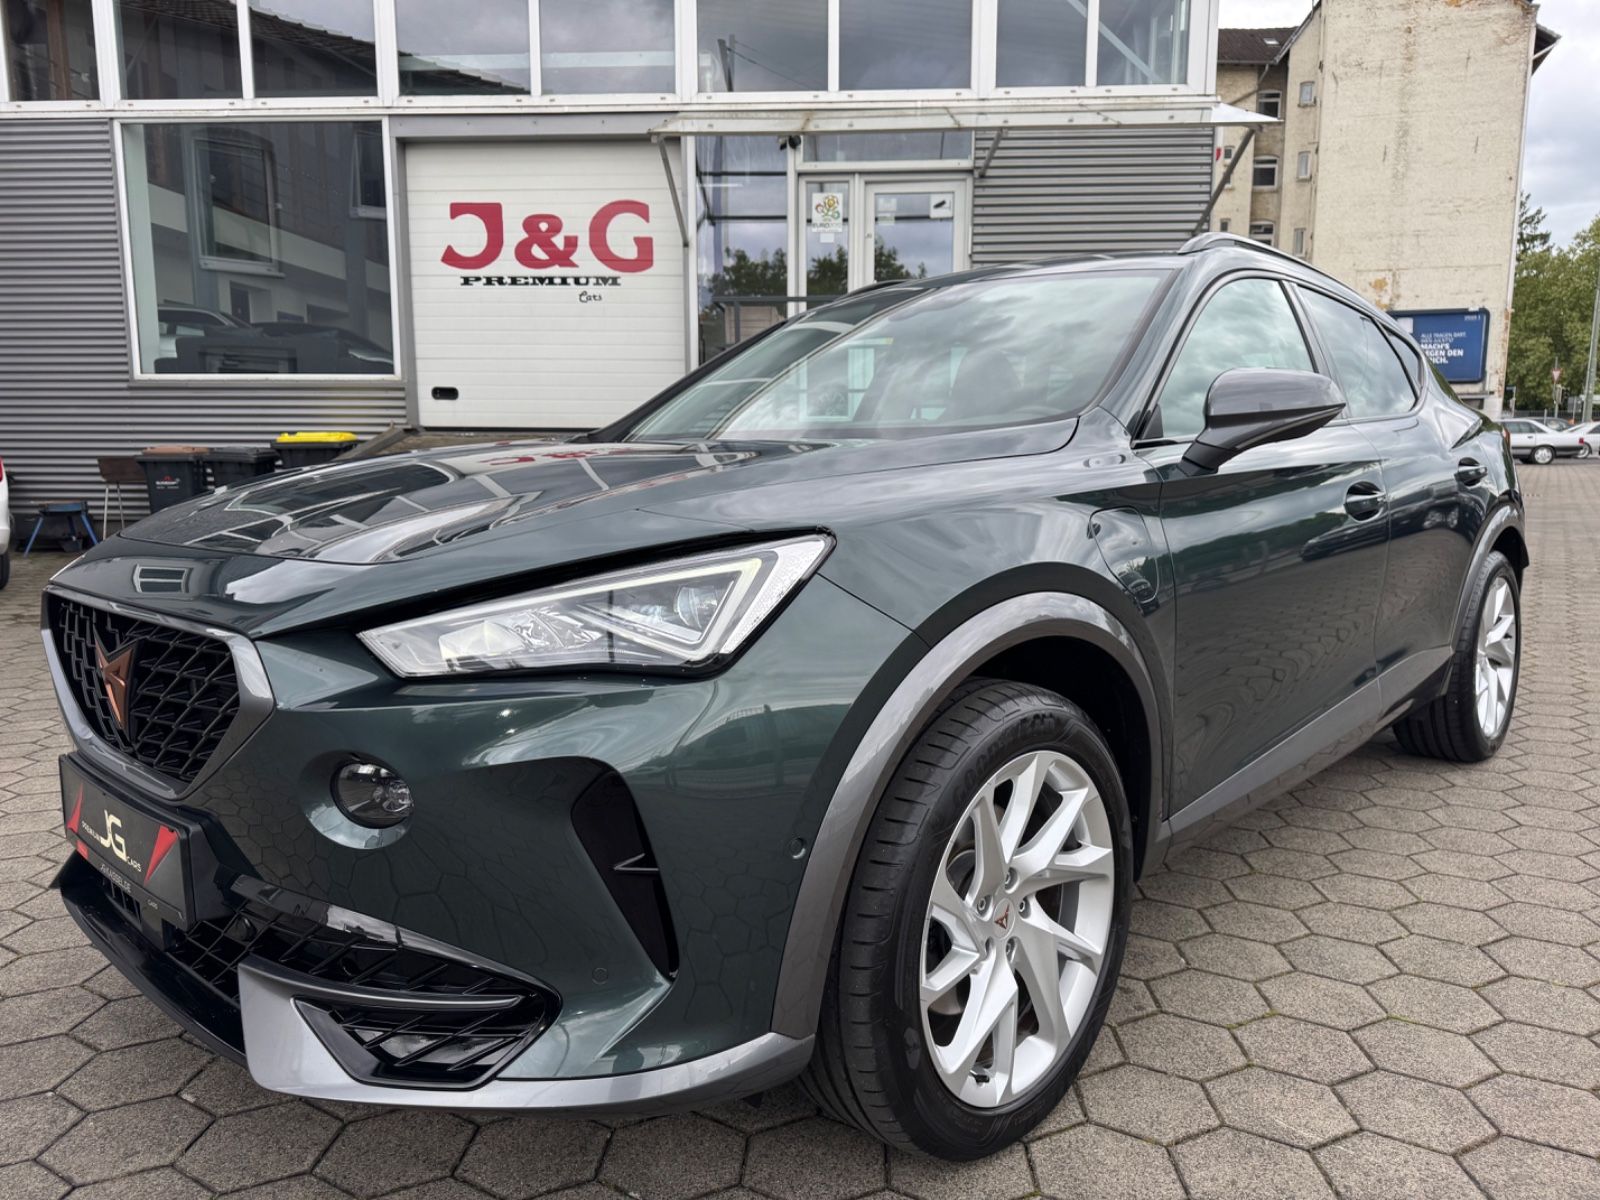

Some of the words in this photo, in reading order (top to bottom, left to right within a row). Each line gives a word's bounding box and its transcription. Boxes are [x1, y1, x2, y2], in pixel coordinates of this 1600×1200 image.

[460, 276, 621, 286] PREMIUM
[578, 290, 602, 303] Cars
[1447, 349, 1464, 357] DEN
